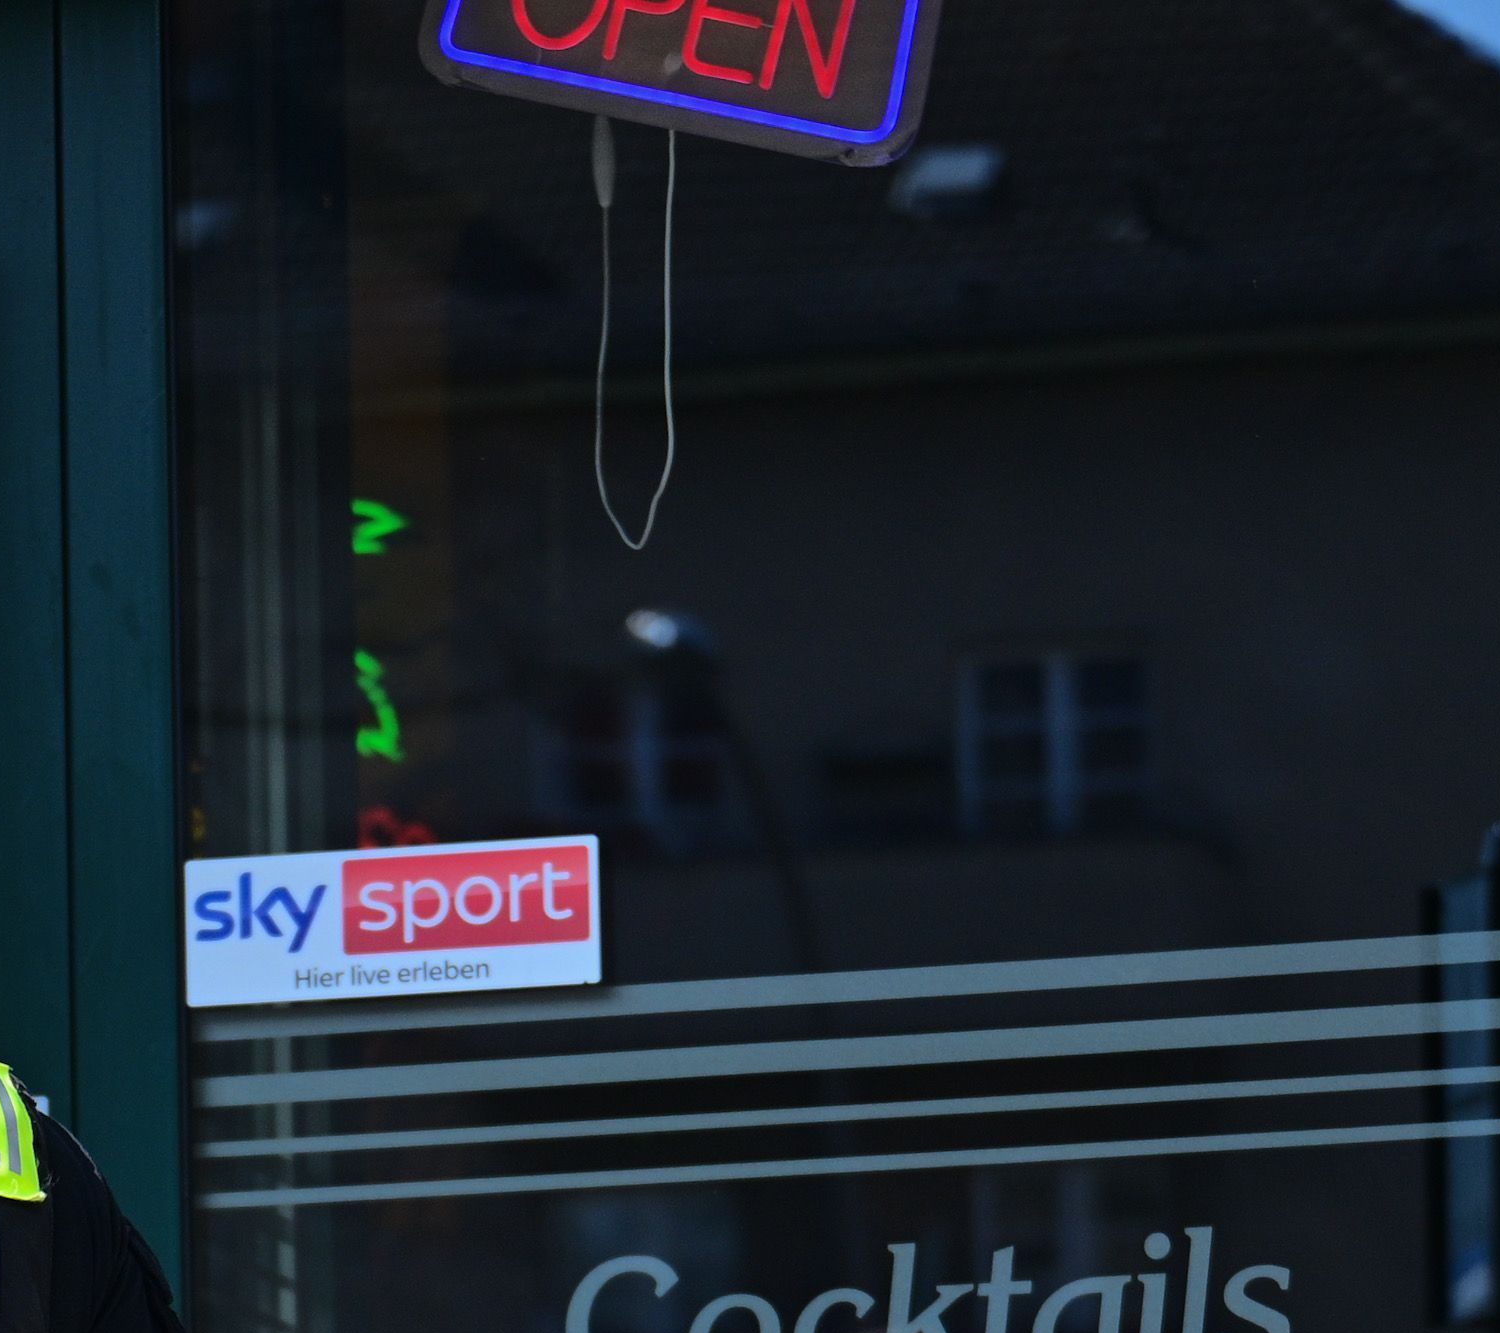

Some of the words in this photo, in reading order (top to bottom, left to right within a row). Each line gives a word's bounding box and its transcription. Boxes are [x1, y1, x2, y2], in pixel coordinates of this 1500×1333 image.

[194, 871, 328, 953] sky
[358, 861, 574, 943] sport
[294, 968, 345, 989] Hier
[350, 963, 391, 986] live
[398, 959, 490, 983] erleben
